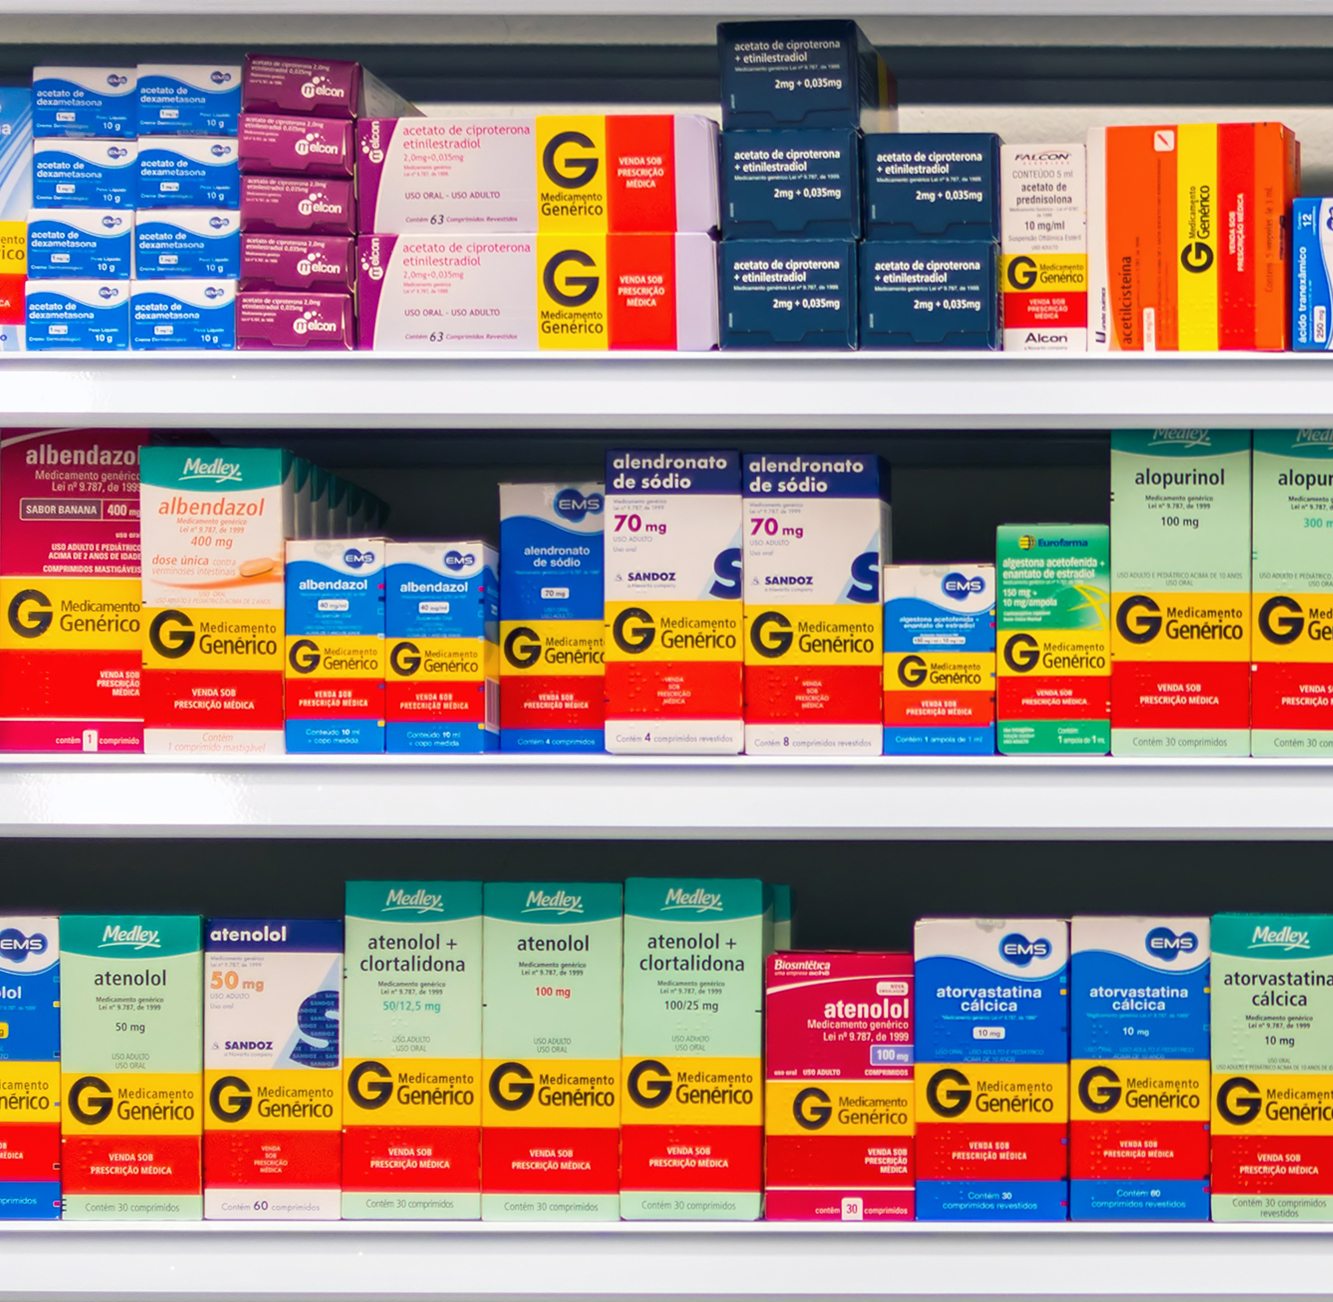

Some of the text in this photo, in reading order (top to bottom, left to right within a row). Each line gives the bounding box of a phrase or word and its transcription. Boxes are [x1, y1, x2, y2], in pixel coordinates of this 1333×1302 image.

[402, 124, 531, 137] acetato de ciproterona
[1014, 153, 1070, 161] FALCON
[915, 190, 936, 203] 2mg
[944, 189, 983, 203] 0,035mg
[1024, 220, 1065, 233] 10 mg/ml
[1119, 256, 1133, 345] acetilcisteína
[1024, 332, 1068, 343] Alcon
[612, 453, 728, 470] alendronato
[612, 472, 692, 489] de sódio
[1134, 467, 1225, 490] alopurinol
[25, 504, 98, 515] SABOR BANANA
[158, 496, 265, 516] albendazol
[1037, 538, 1089, 547] Eurofarma
[191, 688, 237, 697] VENDA SOB
[174, 699, 255, 711] PRESCRIÇÃO MÉDICA
[210, 925, 287, 942] atenolol
[360, 954, 465, 972] clortalidona
[1251, 990, 1307, 1007] cálcica
[664, 1000, 719, 1013] 100/25 mg
[221, 1200, 320, 1213] Contém 60 comprimidos
